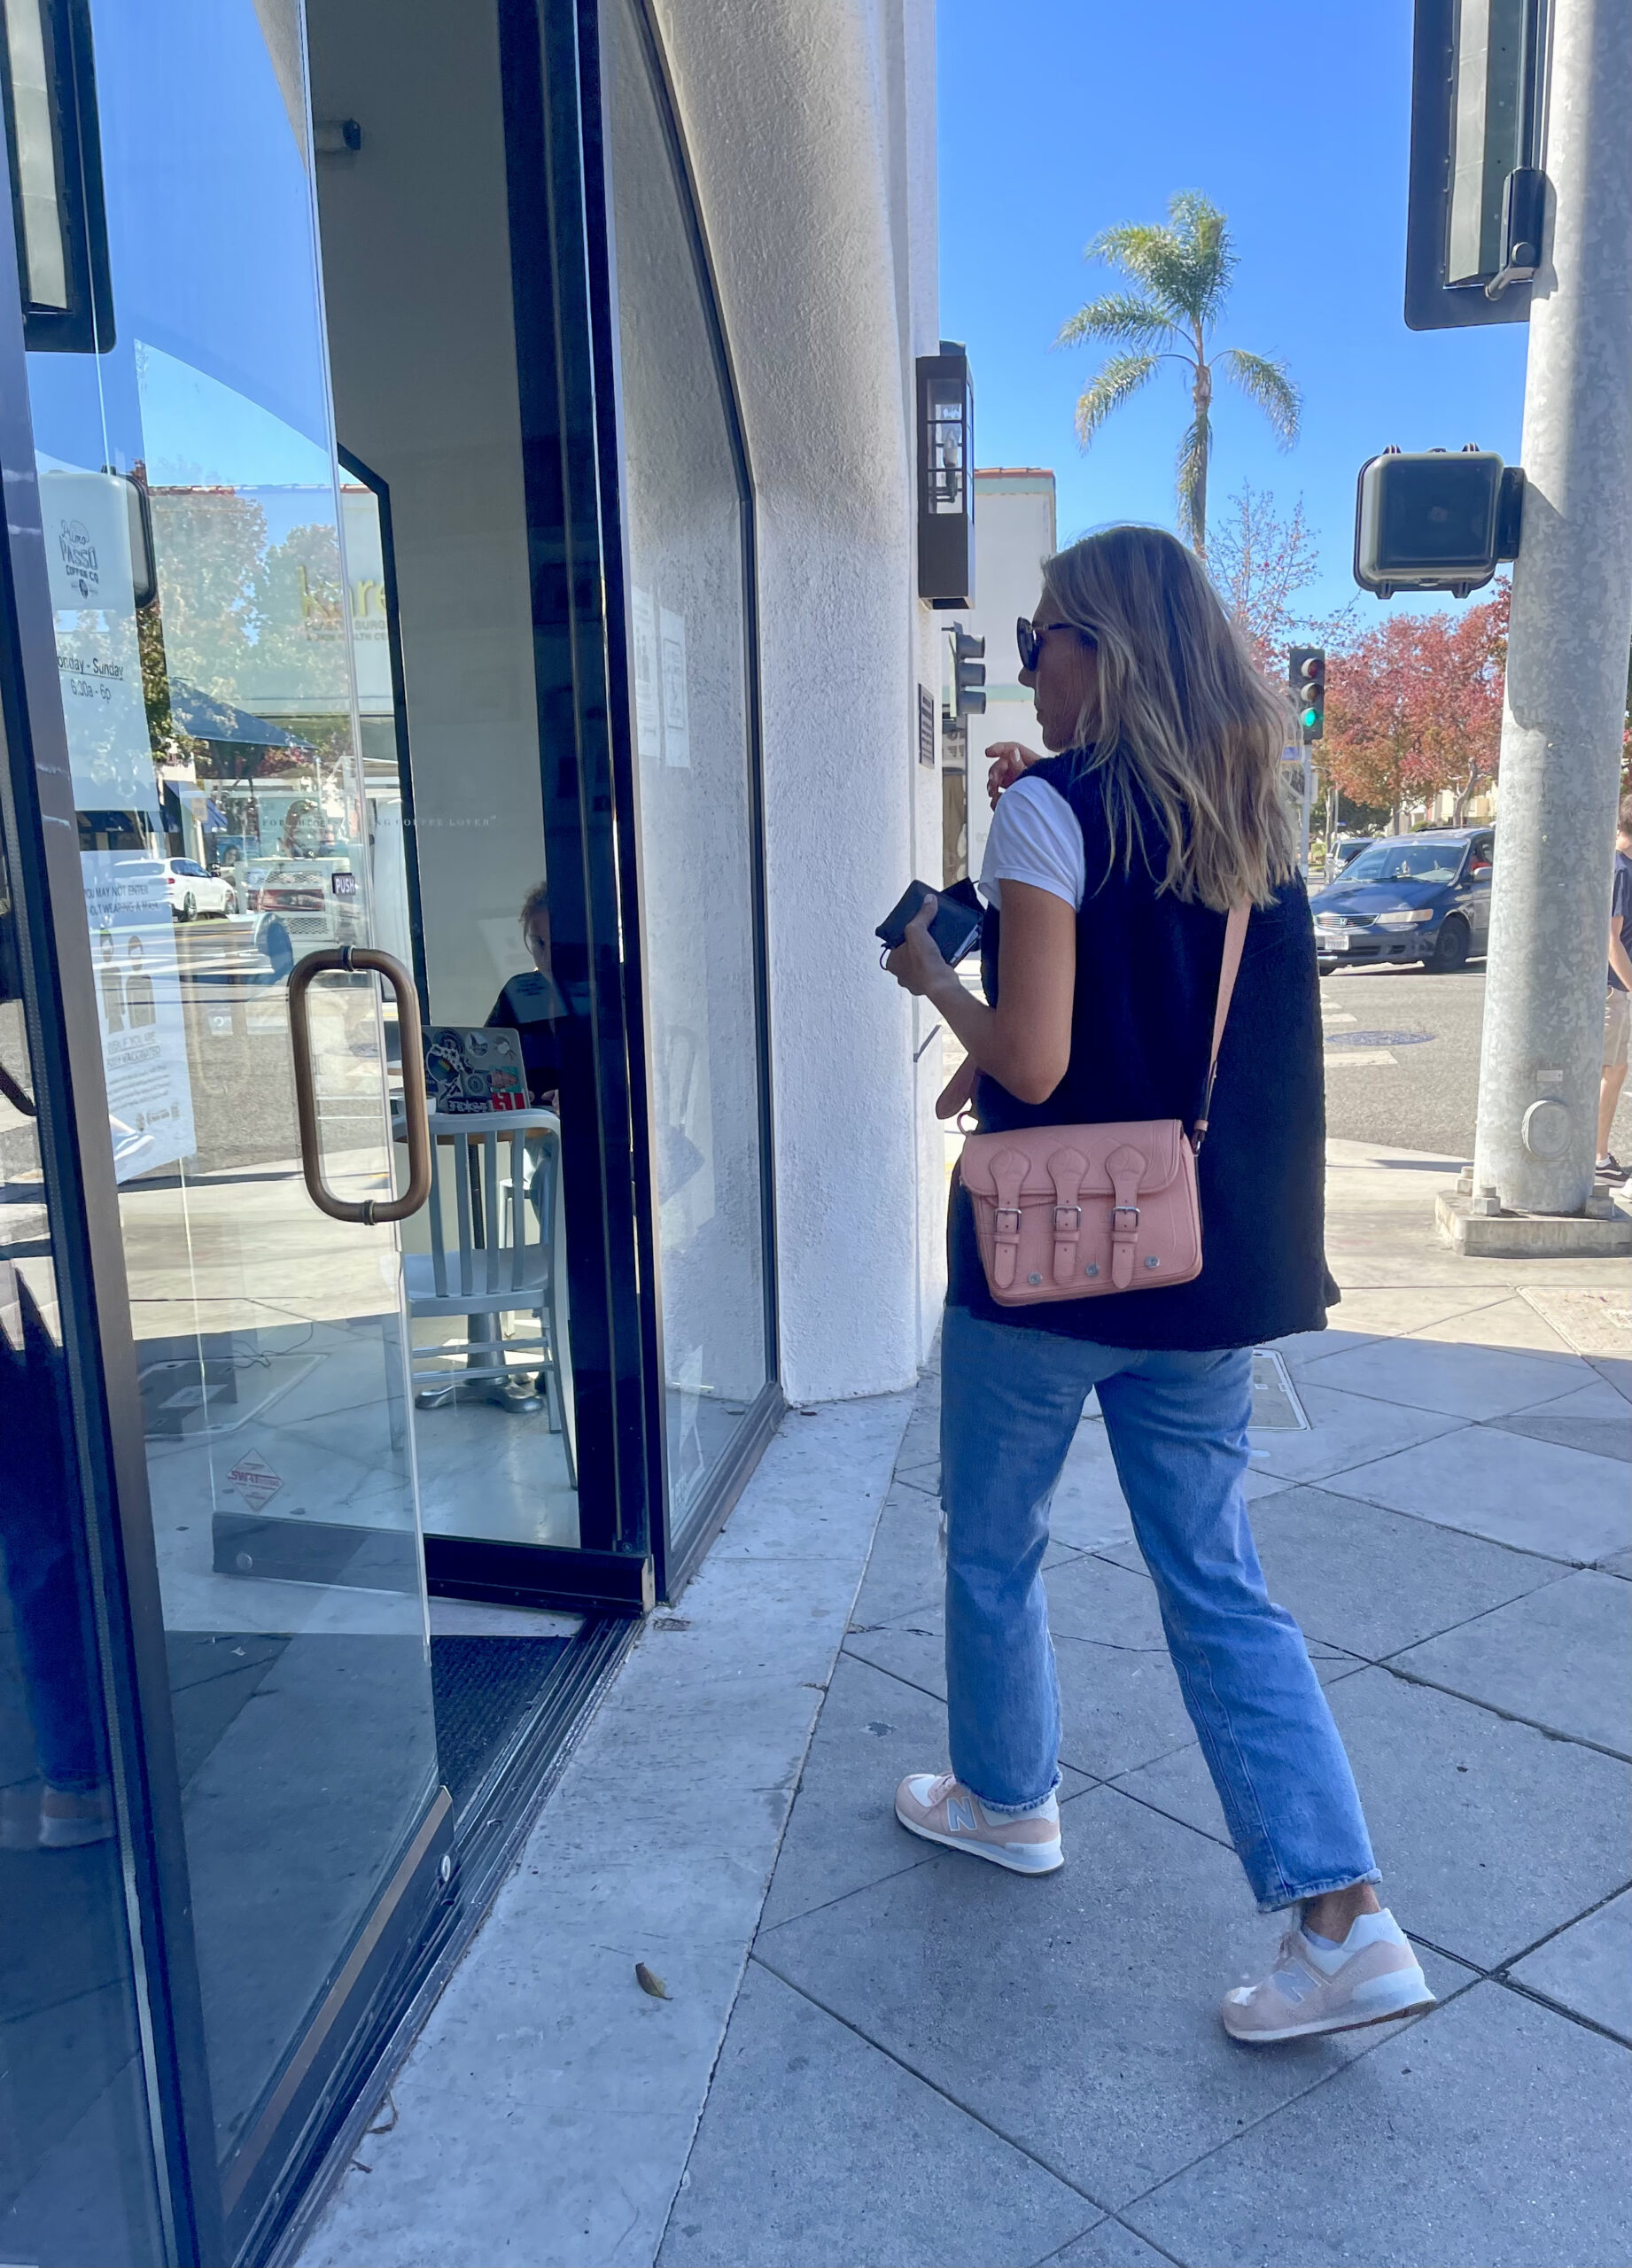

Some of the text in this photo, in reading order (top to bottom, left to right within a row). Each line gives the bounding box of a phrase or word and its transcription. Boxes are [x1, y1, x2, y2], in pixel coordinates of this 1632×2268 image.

[59, 535, 98, 570] PASSO
[58, 656, 85, 674] onday
[93, 657, 123, 680] Sunday
[100, 683, 112, 703] 6p
[96, 887, 110, 897] MAY
[112, 885, 127, 897] NOT
[128, 885, 149, 896] ENTER
[336, 878, 354, 893] PUSH
